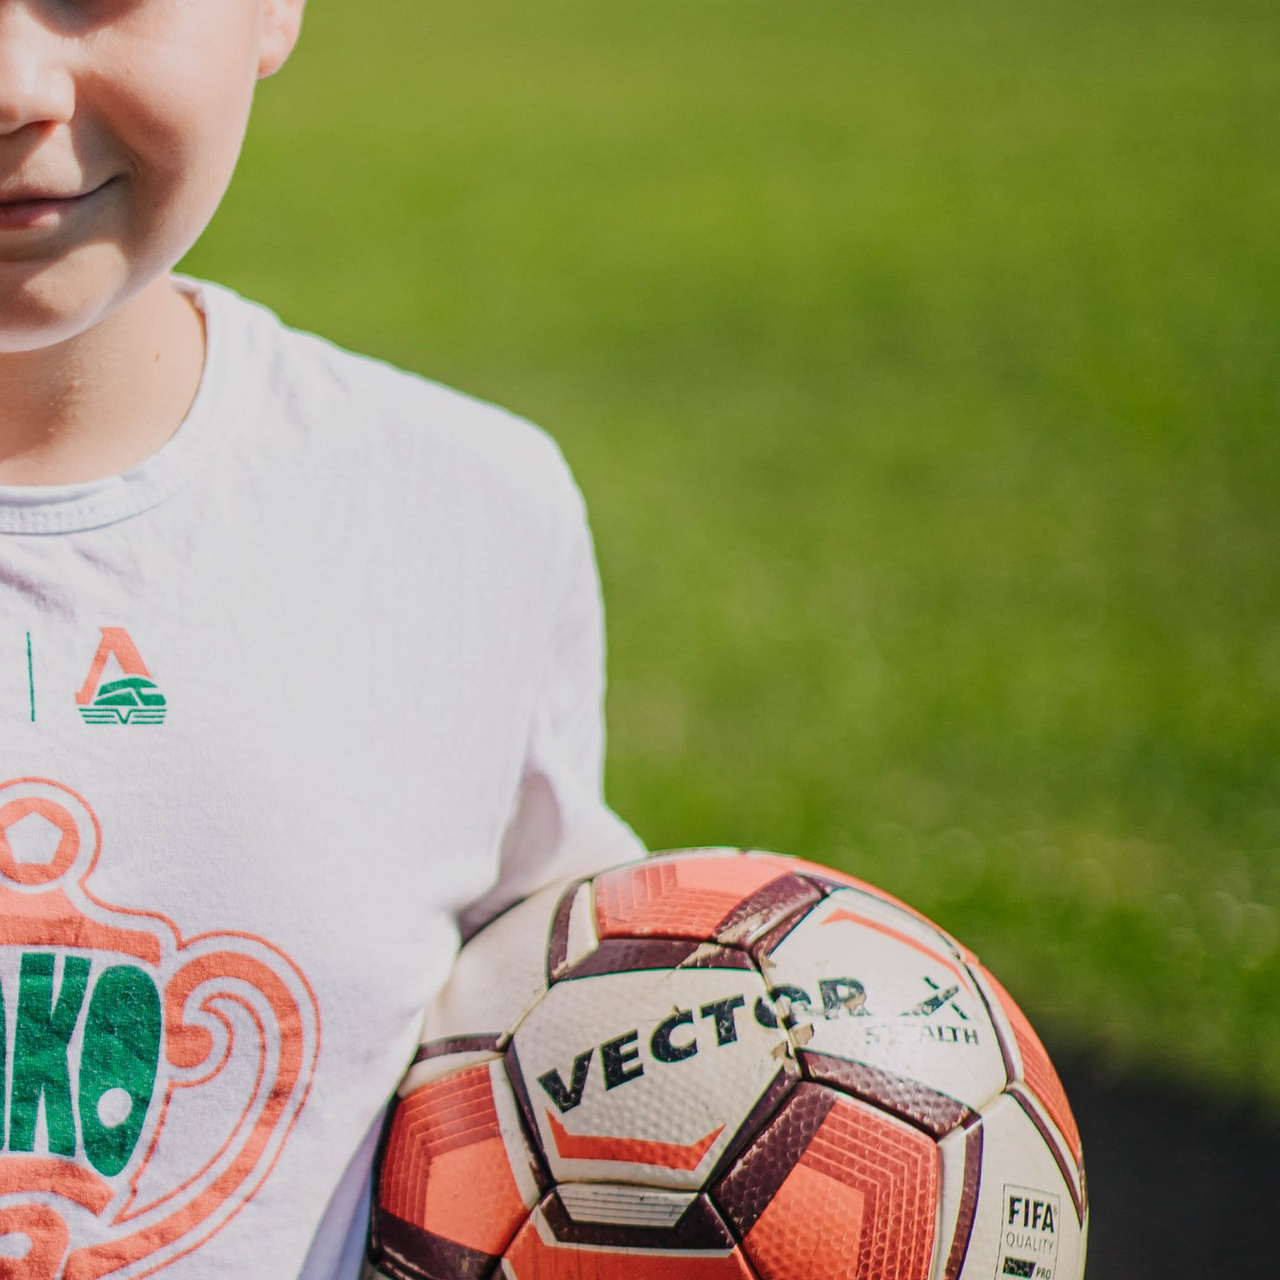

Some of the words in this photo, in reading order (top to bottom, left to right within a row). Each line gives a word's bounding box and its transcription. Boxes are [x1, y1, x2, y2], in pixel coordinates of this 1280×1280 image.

[1008, 1194, 1055, 1233] FIFA
[1005, 1231, 1054, 1254] QUALITY
[1036, 1266, 1052, 1280] PRO
